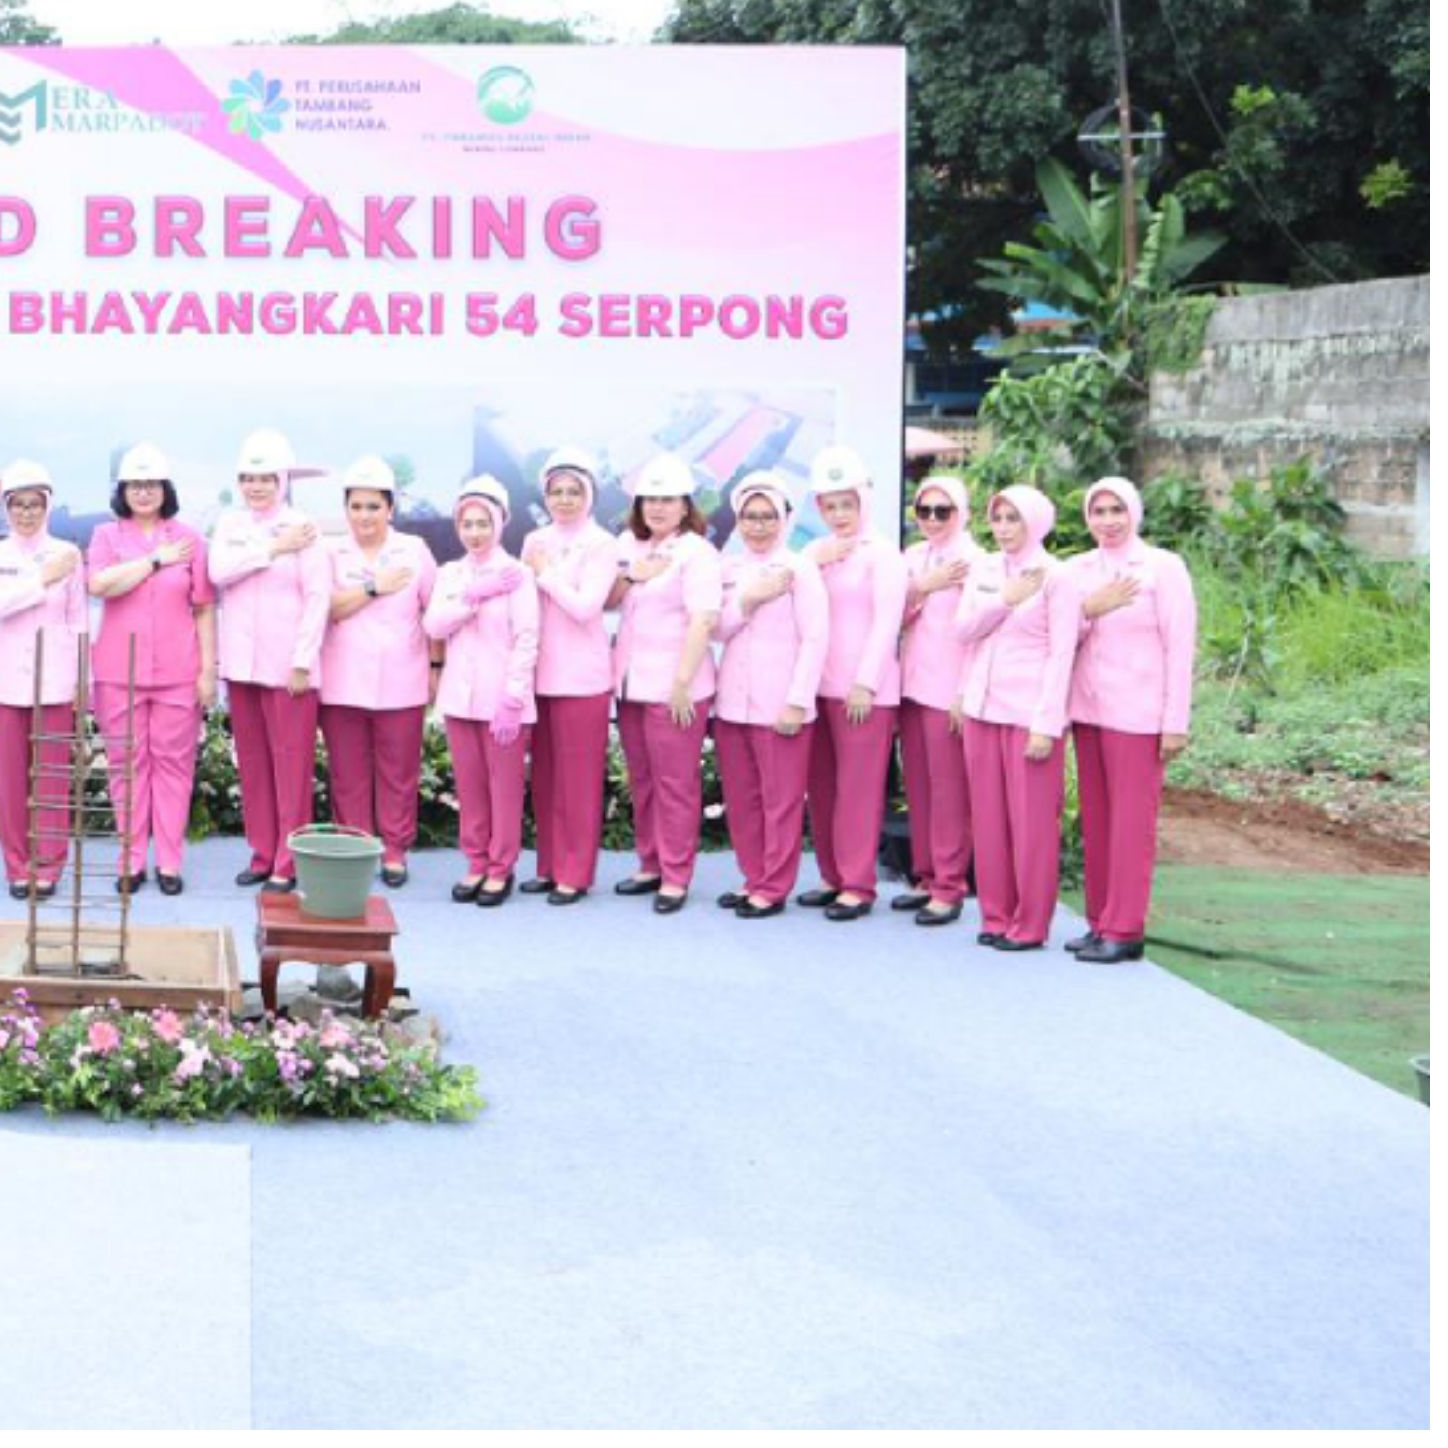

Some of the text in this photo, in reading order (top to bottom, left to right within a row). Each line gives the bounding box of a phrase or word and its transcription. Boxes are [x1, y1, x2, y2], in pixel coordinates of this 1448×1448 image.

[50, 85, 120, 110] ERA
[84, 195, 603, 263] BREAKING
[8, 292, 445, 337] BHAYANGKARI
[464, 294, 539, 338] 54
[558, 294, 850, 341] SERPONG
